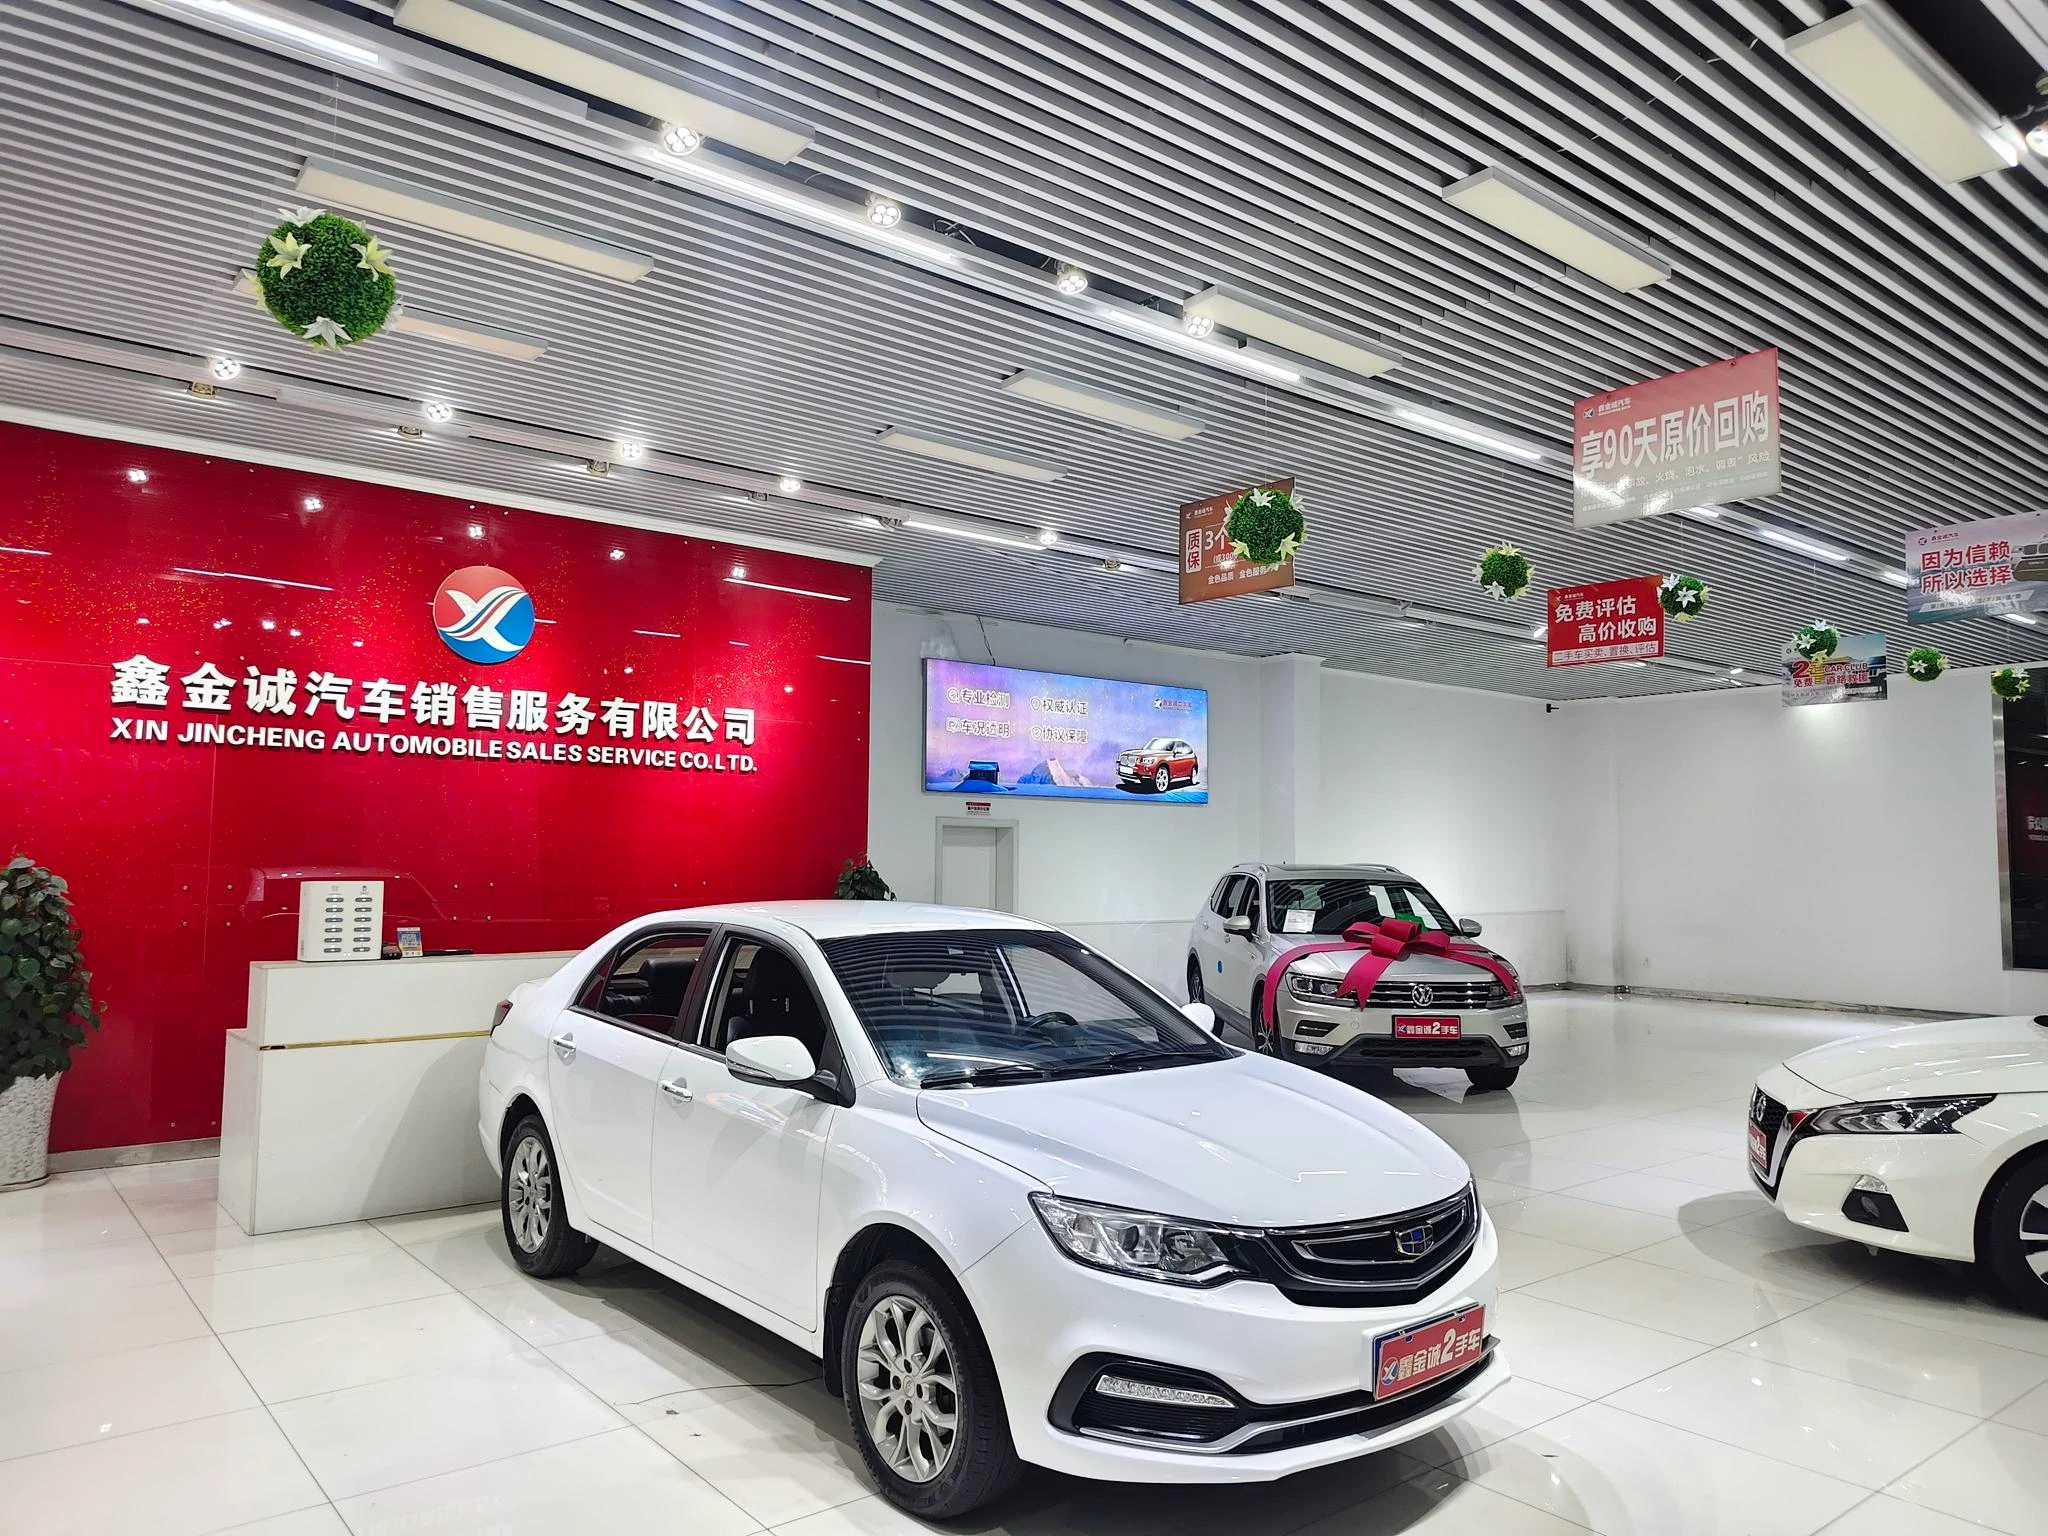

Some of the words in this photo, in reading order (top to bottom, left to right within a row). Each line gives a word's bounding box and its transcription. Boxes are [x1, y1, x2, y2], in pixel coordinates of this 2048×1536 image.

[1580, 390, 1769, 479] 享90天原价回购
[1188, 531, 1200, 570] 质保
[1921, 540, 2010, 571] 因为信赖
[1922, 564, 2012, 594] 所以选择
[1555, 595, 1637, 623] 免费评估
[1578, 616, 1657, 643] 高价收购
[1554, 642, 1656, 662] 二手车买卖、置换、评估
[1824, 664, 1843, 673] CAR
[1844, 662, 1869, 671] CLUB
[111, 653, 756, 745] 鑫金诚汽车销售服务有限公司
[962, 689, 1010, 708] 专业检测
[1043, 698, 1088, 716] 权威认证
[110, 717, 169, 741] XIN
[177, 722, 326, 750] JINCHENG
[332, 731, 503, 759] AUTOMOBILE
[506, 741, 583, 763] SALES
[586, 746, 677, 768] SERVICE
[962, 720, 1010, 738] 车况透明
[1043, 726, 1088, 743] 协议保障
[1398, 1328, 1481, 1381] 鑫金诚2手车
